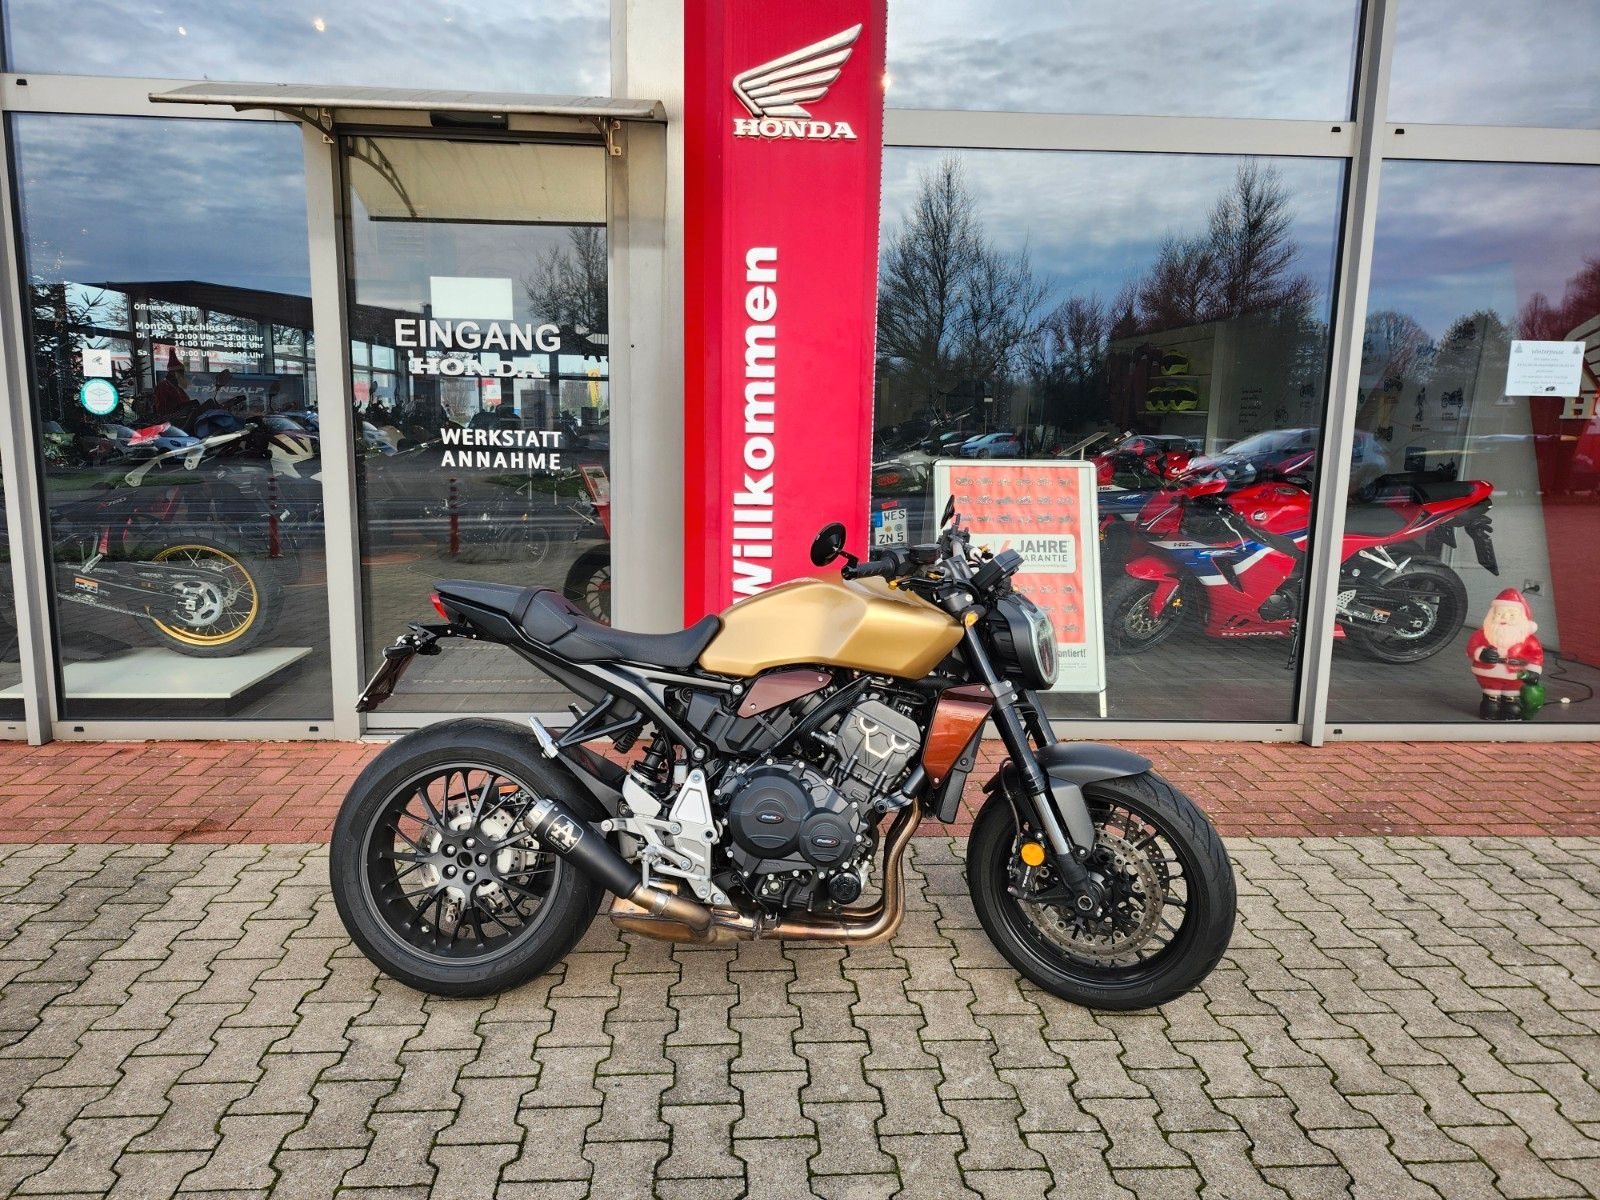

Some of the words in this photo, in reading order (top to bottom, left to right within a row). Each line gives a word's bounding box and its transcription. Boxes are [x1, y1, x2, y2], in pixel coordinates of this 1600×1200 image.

[733, 118, 858, 140] HONDA
[135, 321, 173, 331] Montag
[176, 322, 239, 332] geschlossen
[249, 334, 264, 342] Uhr
[394, 318, 561, 352] EINGANG
[249, 341, 264, 349] Uhr
[249, 351, 265, 359] Uhr
[410, 357, 545, 379] HONDA
[195, 385, 265, 394] TRANSALP
[732, 247, 777, 606] Willkommen
[440, 428, 562, 448] WERKSTATT
[441, 450, 561, 470] ANNAHME
[883, 509, 906, 521] WES
[878, 533, 894, 544] ZN
[897, 532, 904, 542] 5
[1017, 540, 1068, 553] JAHRE
[1023, 554, 1068, 562] ARANTIE
[1056, 648, 1086, 658] antiert!
